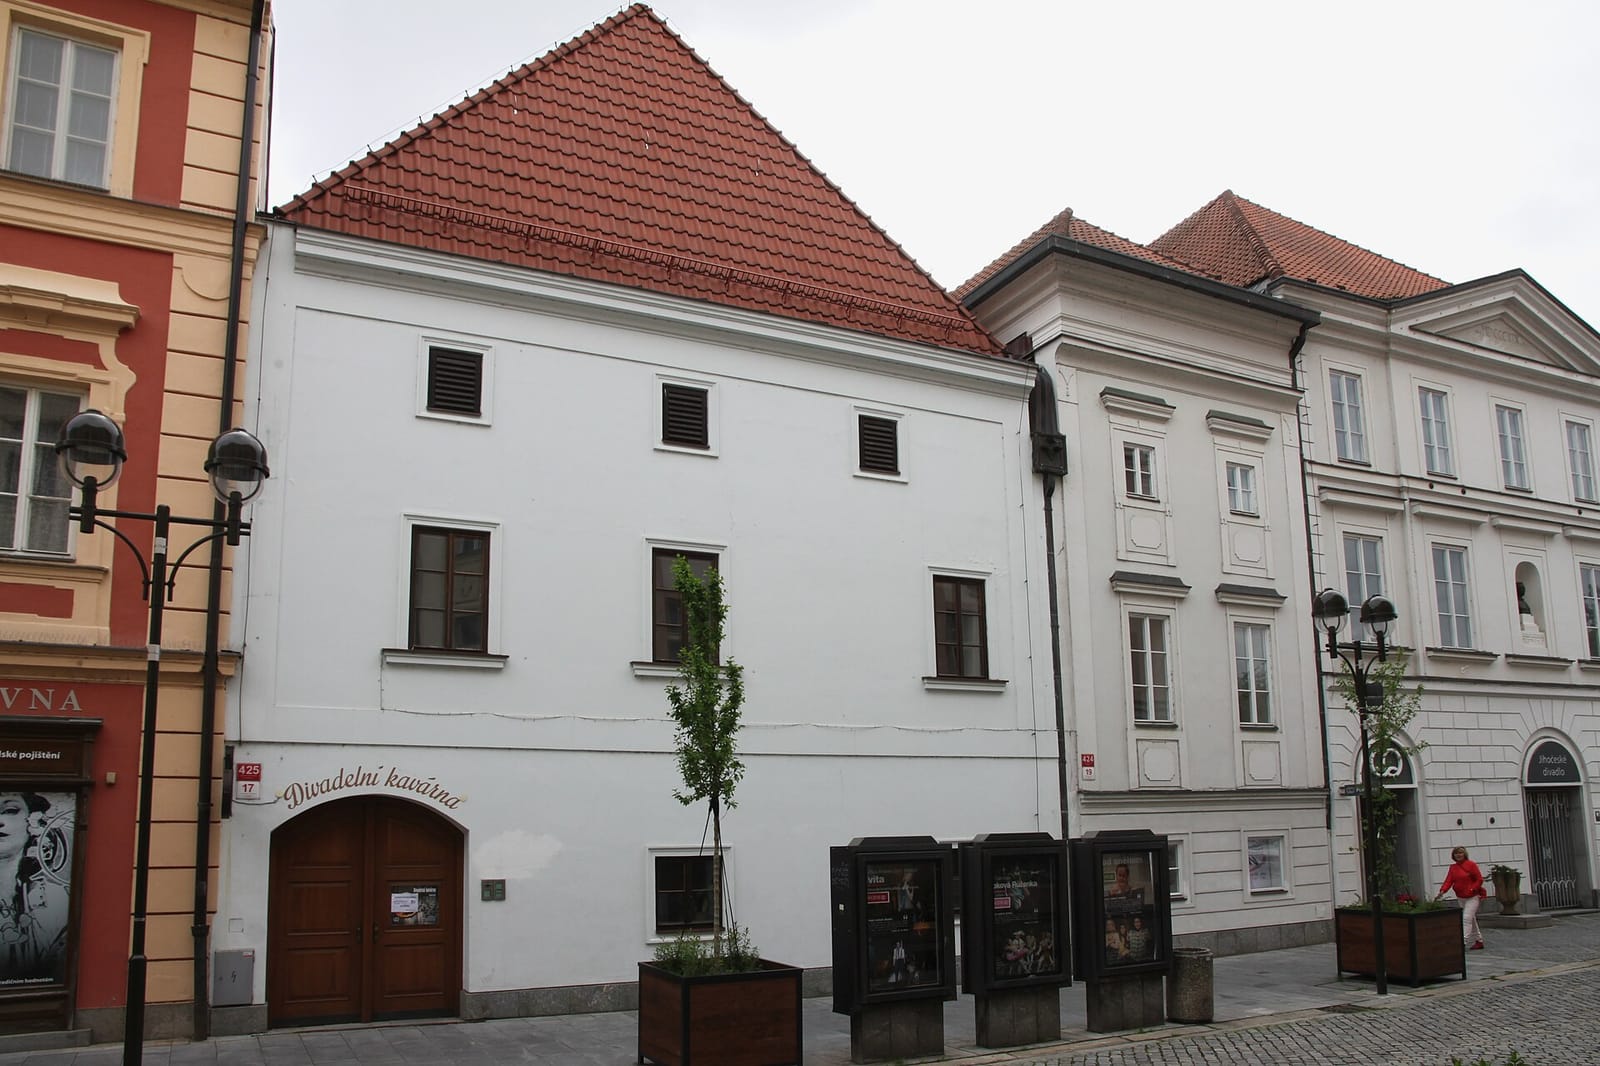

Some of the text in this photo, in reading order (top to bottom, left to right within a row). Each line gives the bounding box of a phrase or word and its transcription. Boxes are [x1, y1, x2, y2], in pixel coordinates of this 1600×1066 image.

[0, 687, 83, 711] VNA
[19, 751, 61, 760] pojištění
[238, 765, 260, 775] 425
[1542, 767, 1566, 776] divadlo
[242, 783, 255, 793] 17
[283, 765, 462, 810] Divadelní kavárna
